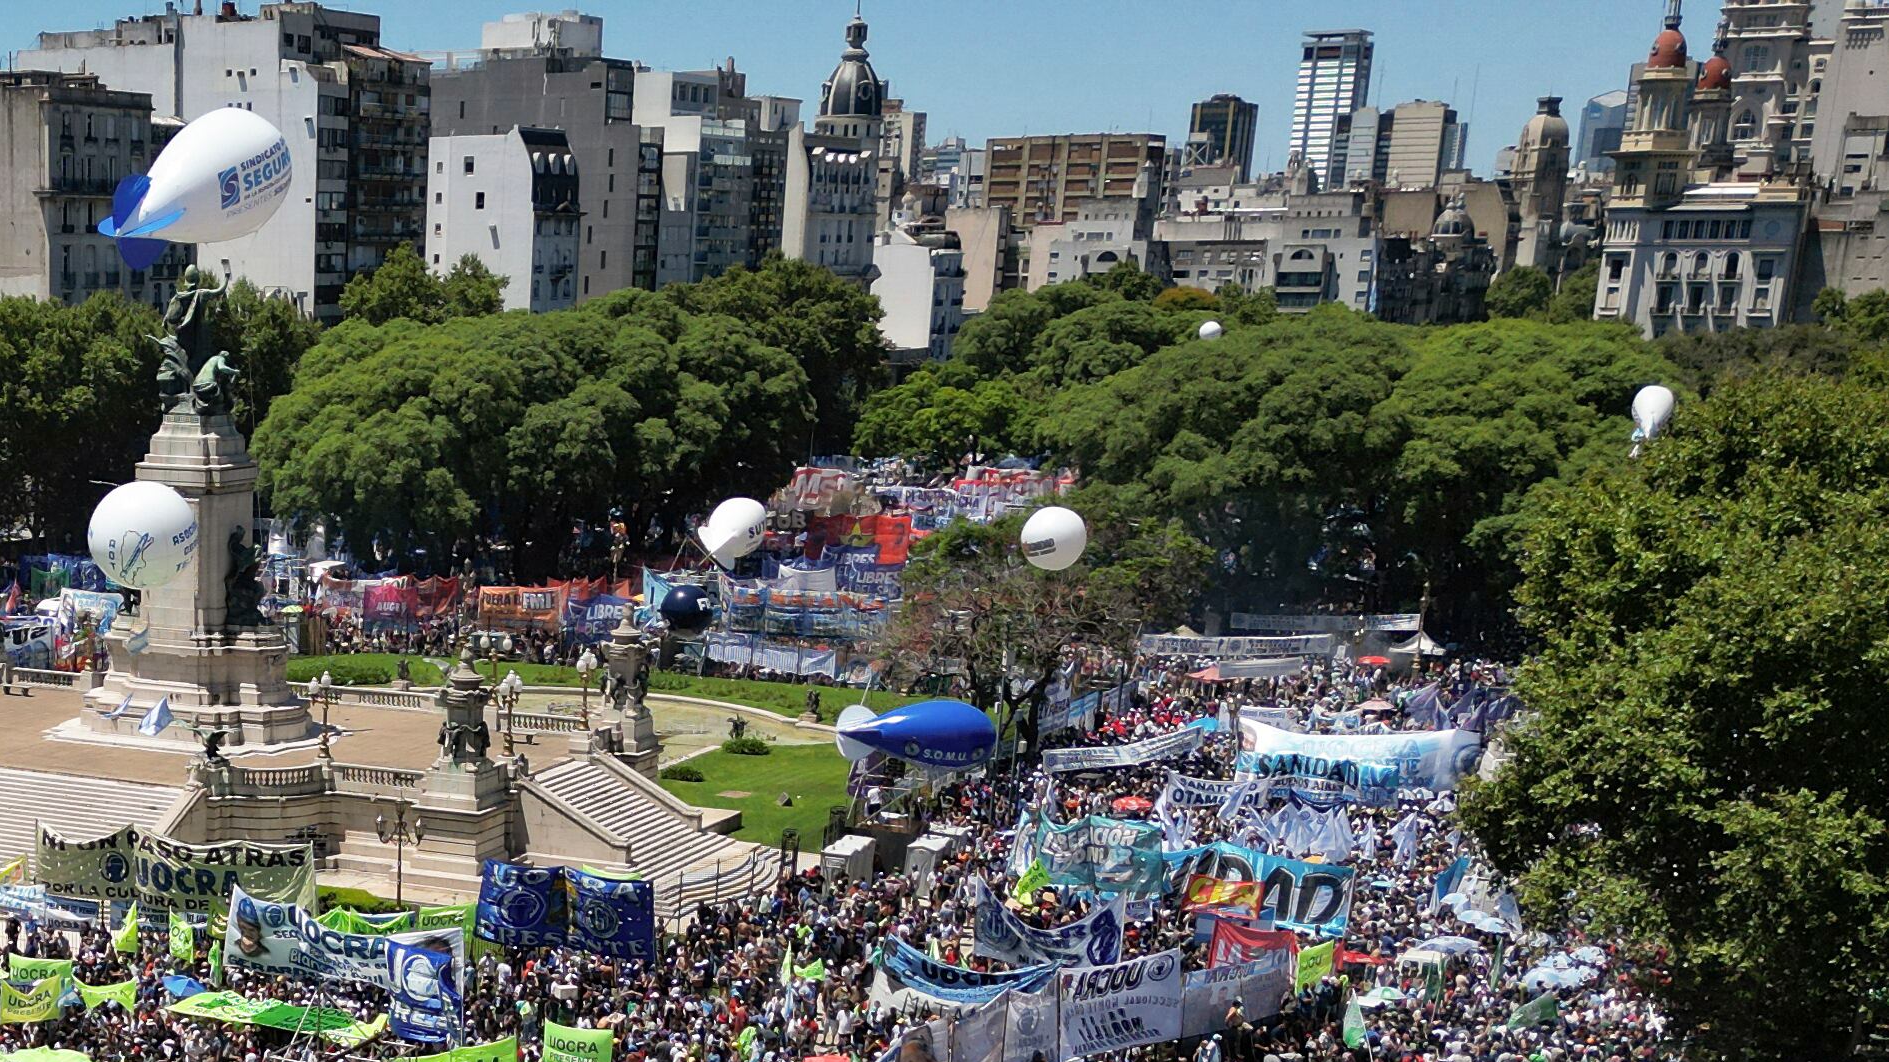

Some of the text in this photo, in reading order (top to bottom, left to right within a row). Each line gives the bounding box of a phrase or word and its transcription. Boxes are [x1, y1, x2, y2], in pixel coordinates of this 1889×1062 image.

[240, 143, 282, 172] SINDICATO
[1257, 756, 1359, 788] SANIDAD
[127, 830, 193, 862] PASO
[204, 846, 306, 868] ATRAS
[45, 881, 76, 895] POR
[79, 884, 100, 896] LA
[135, 856, 241, 896] UOCRA
[288, 903, 387, 961] UOCRA
[11, 966, 58, 981] UOCRA
[549, 1035, 599, 1053] UOCRA
